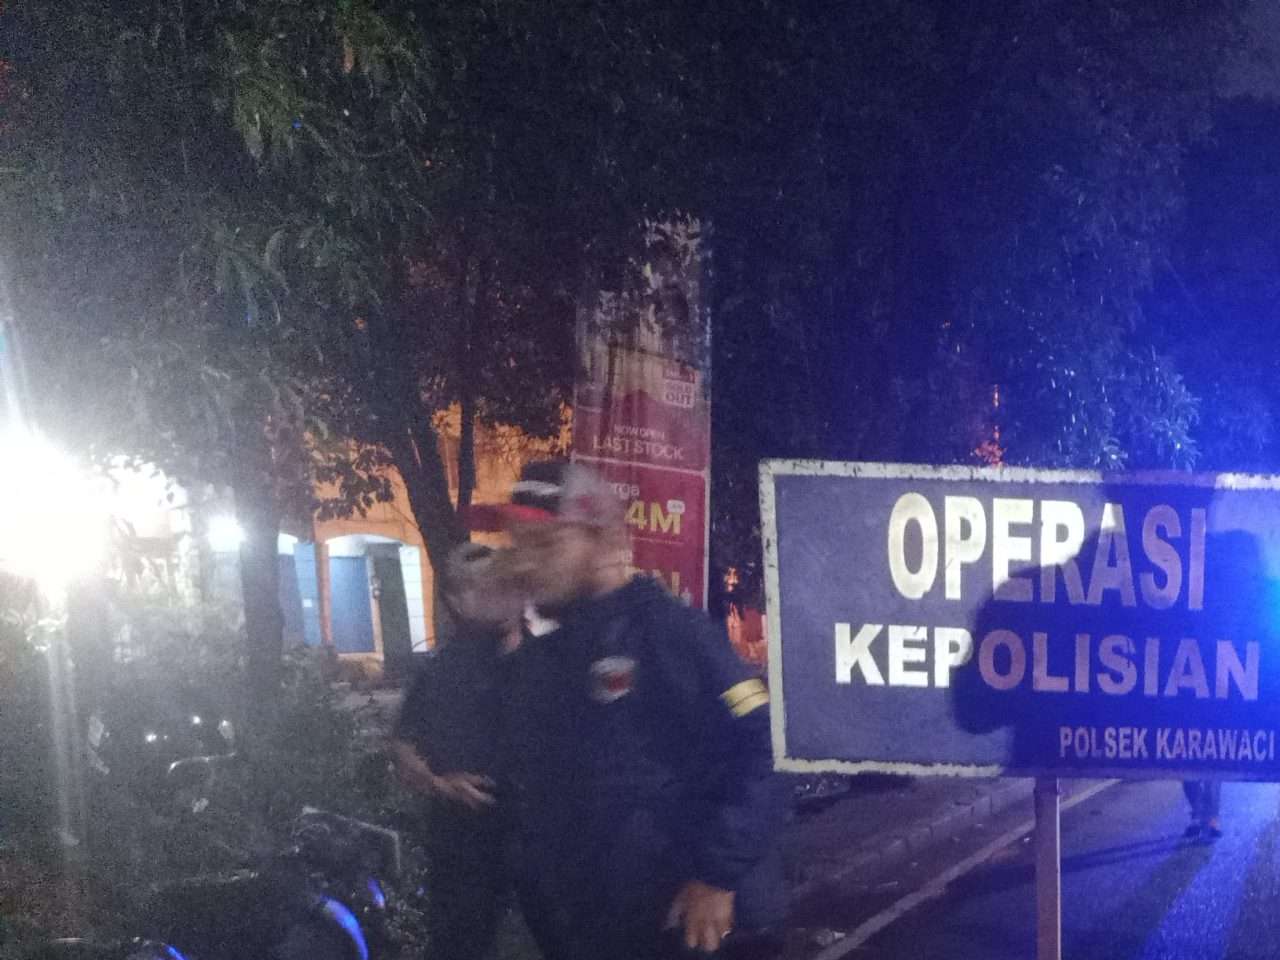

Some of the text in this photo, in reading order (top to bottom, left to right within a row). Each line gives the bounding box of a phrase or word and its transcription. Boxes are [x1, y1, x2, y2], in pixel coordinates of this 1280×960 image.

[593, 434, 684, 460] LAST STOCK
[887, 492, 1207, 612] OPERASI
[834, 622, 1261, 700] KEPOLISIAN
[1059, 725, 1276, 761] POLSEK KARAWACI
